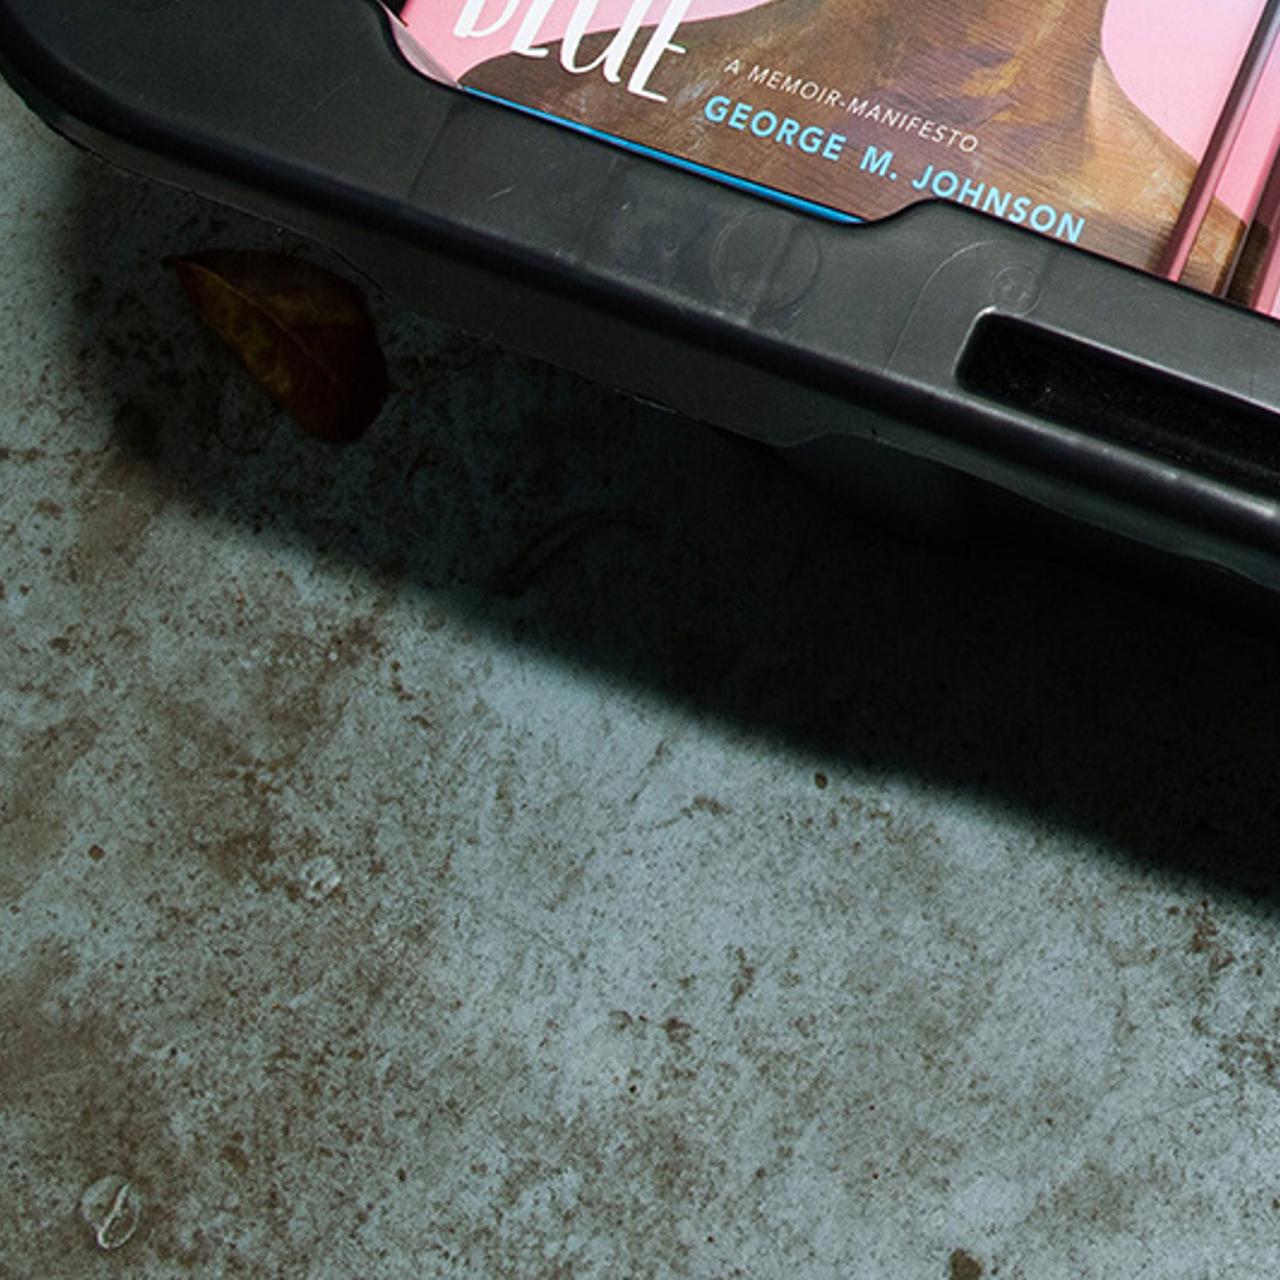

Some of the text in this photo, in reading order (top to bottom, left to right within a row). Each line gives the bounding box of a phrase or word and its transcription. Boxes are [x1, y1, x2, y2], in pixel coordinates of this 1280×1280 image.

[723, 57, 978, 153] A MEMOIR-MANIFESTO
[703, 95, 1086, 243] GEORGE M. JOHNSON
